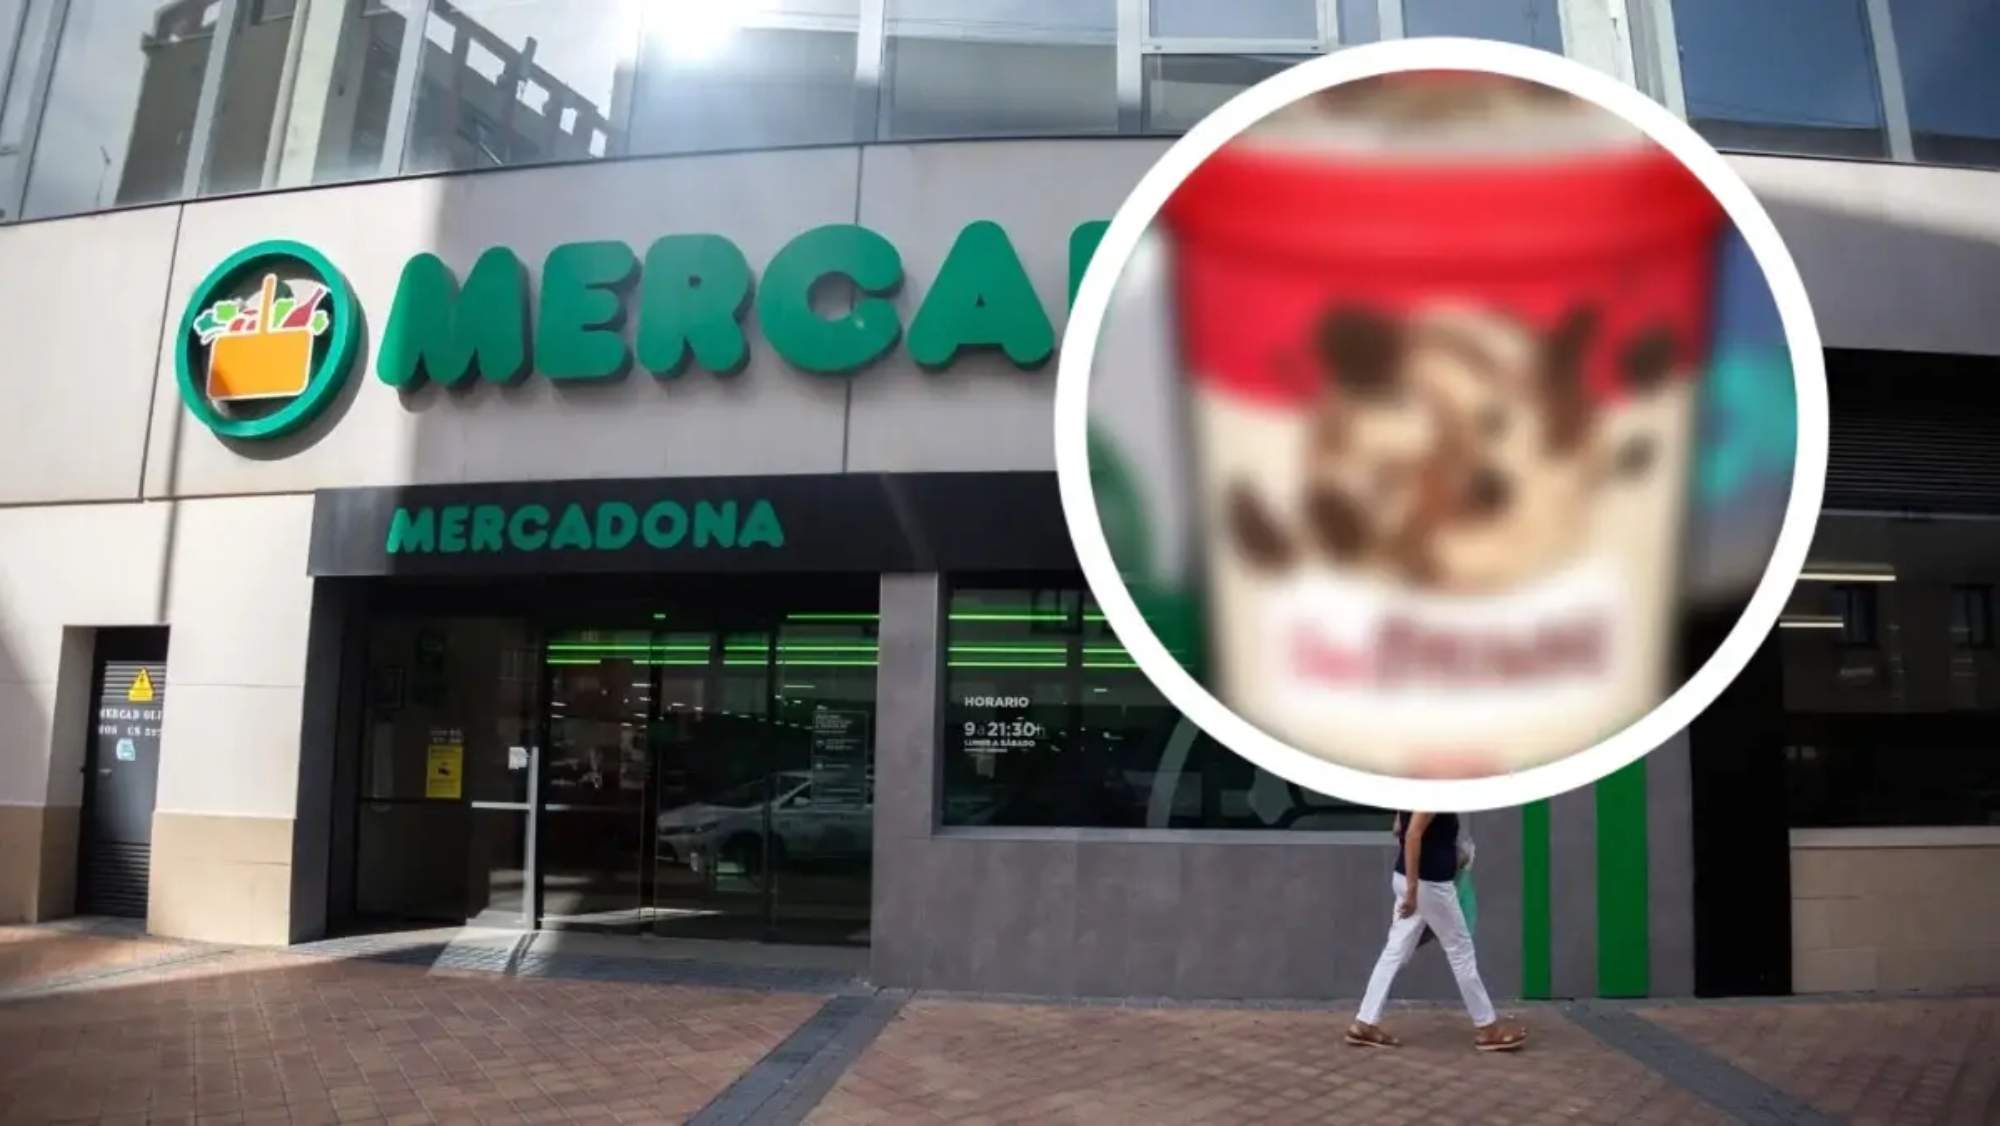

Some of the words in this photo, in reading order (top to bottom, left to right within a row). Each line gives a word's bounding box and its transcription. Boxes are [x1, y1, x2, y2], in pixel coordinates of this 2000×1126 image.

[376, 218, 1107, 392] MERCA
[386, 499, 785, 554] MERCADONA
[964, 696, 1029, 708] HORARIO
[964, 721, 976, 737] 9
